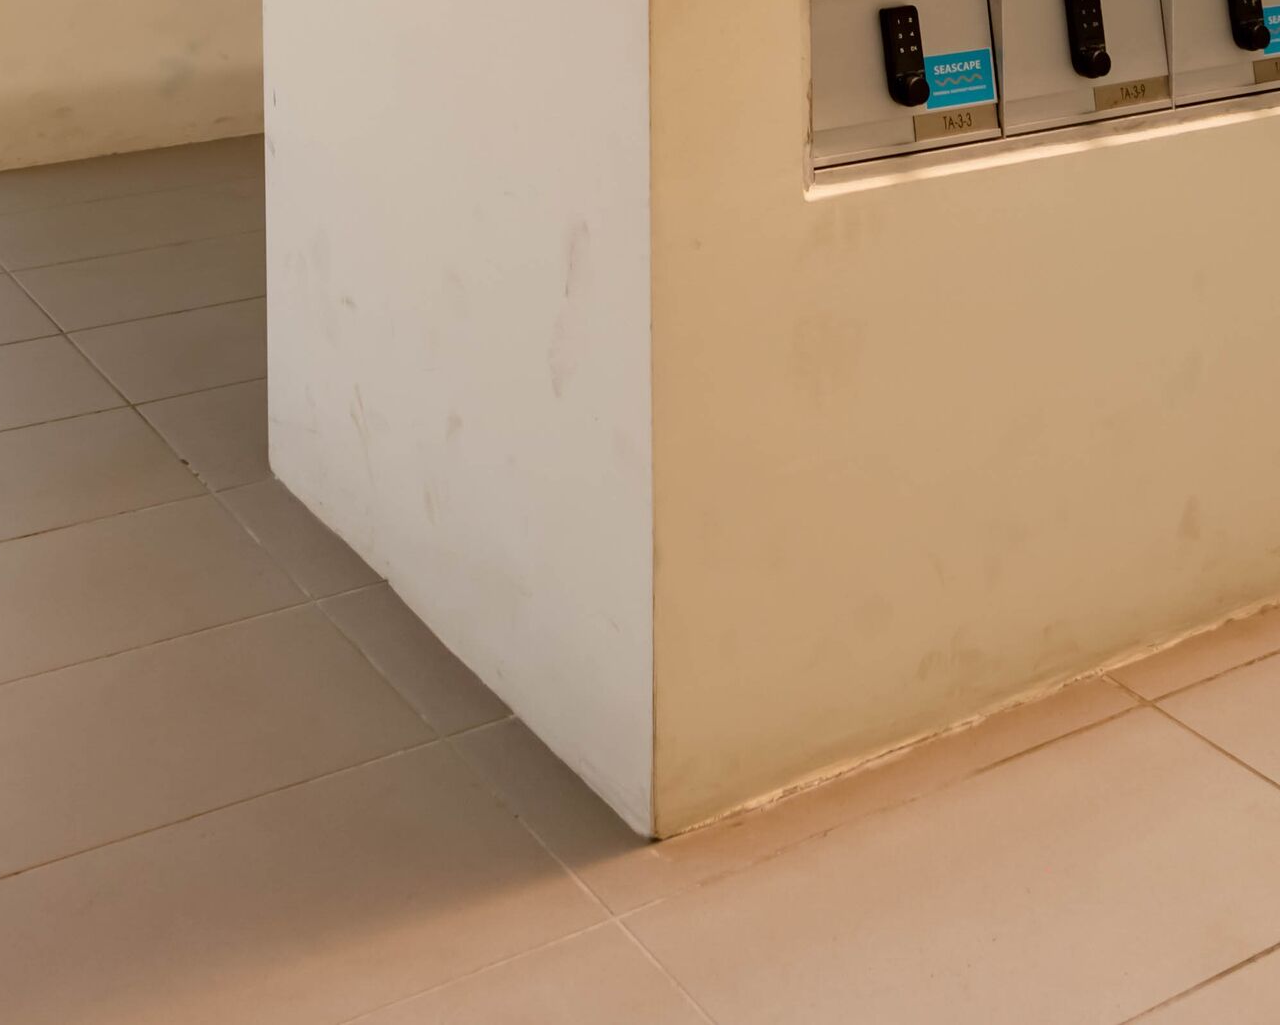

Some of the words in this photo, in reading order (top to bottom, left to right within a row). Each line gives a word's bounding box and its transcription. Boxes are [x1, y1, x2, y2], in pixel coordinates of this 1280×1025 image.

[933, 59, 981, 75] SEASCAPE
[1120, 84, 1146, 100] TA-3-9
[943, 113, 972, 130] TA-3-3
